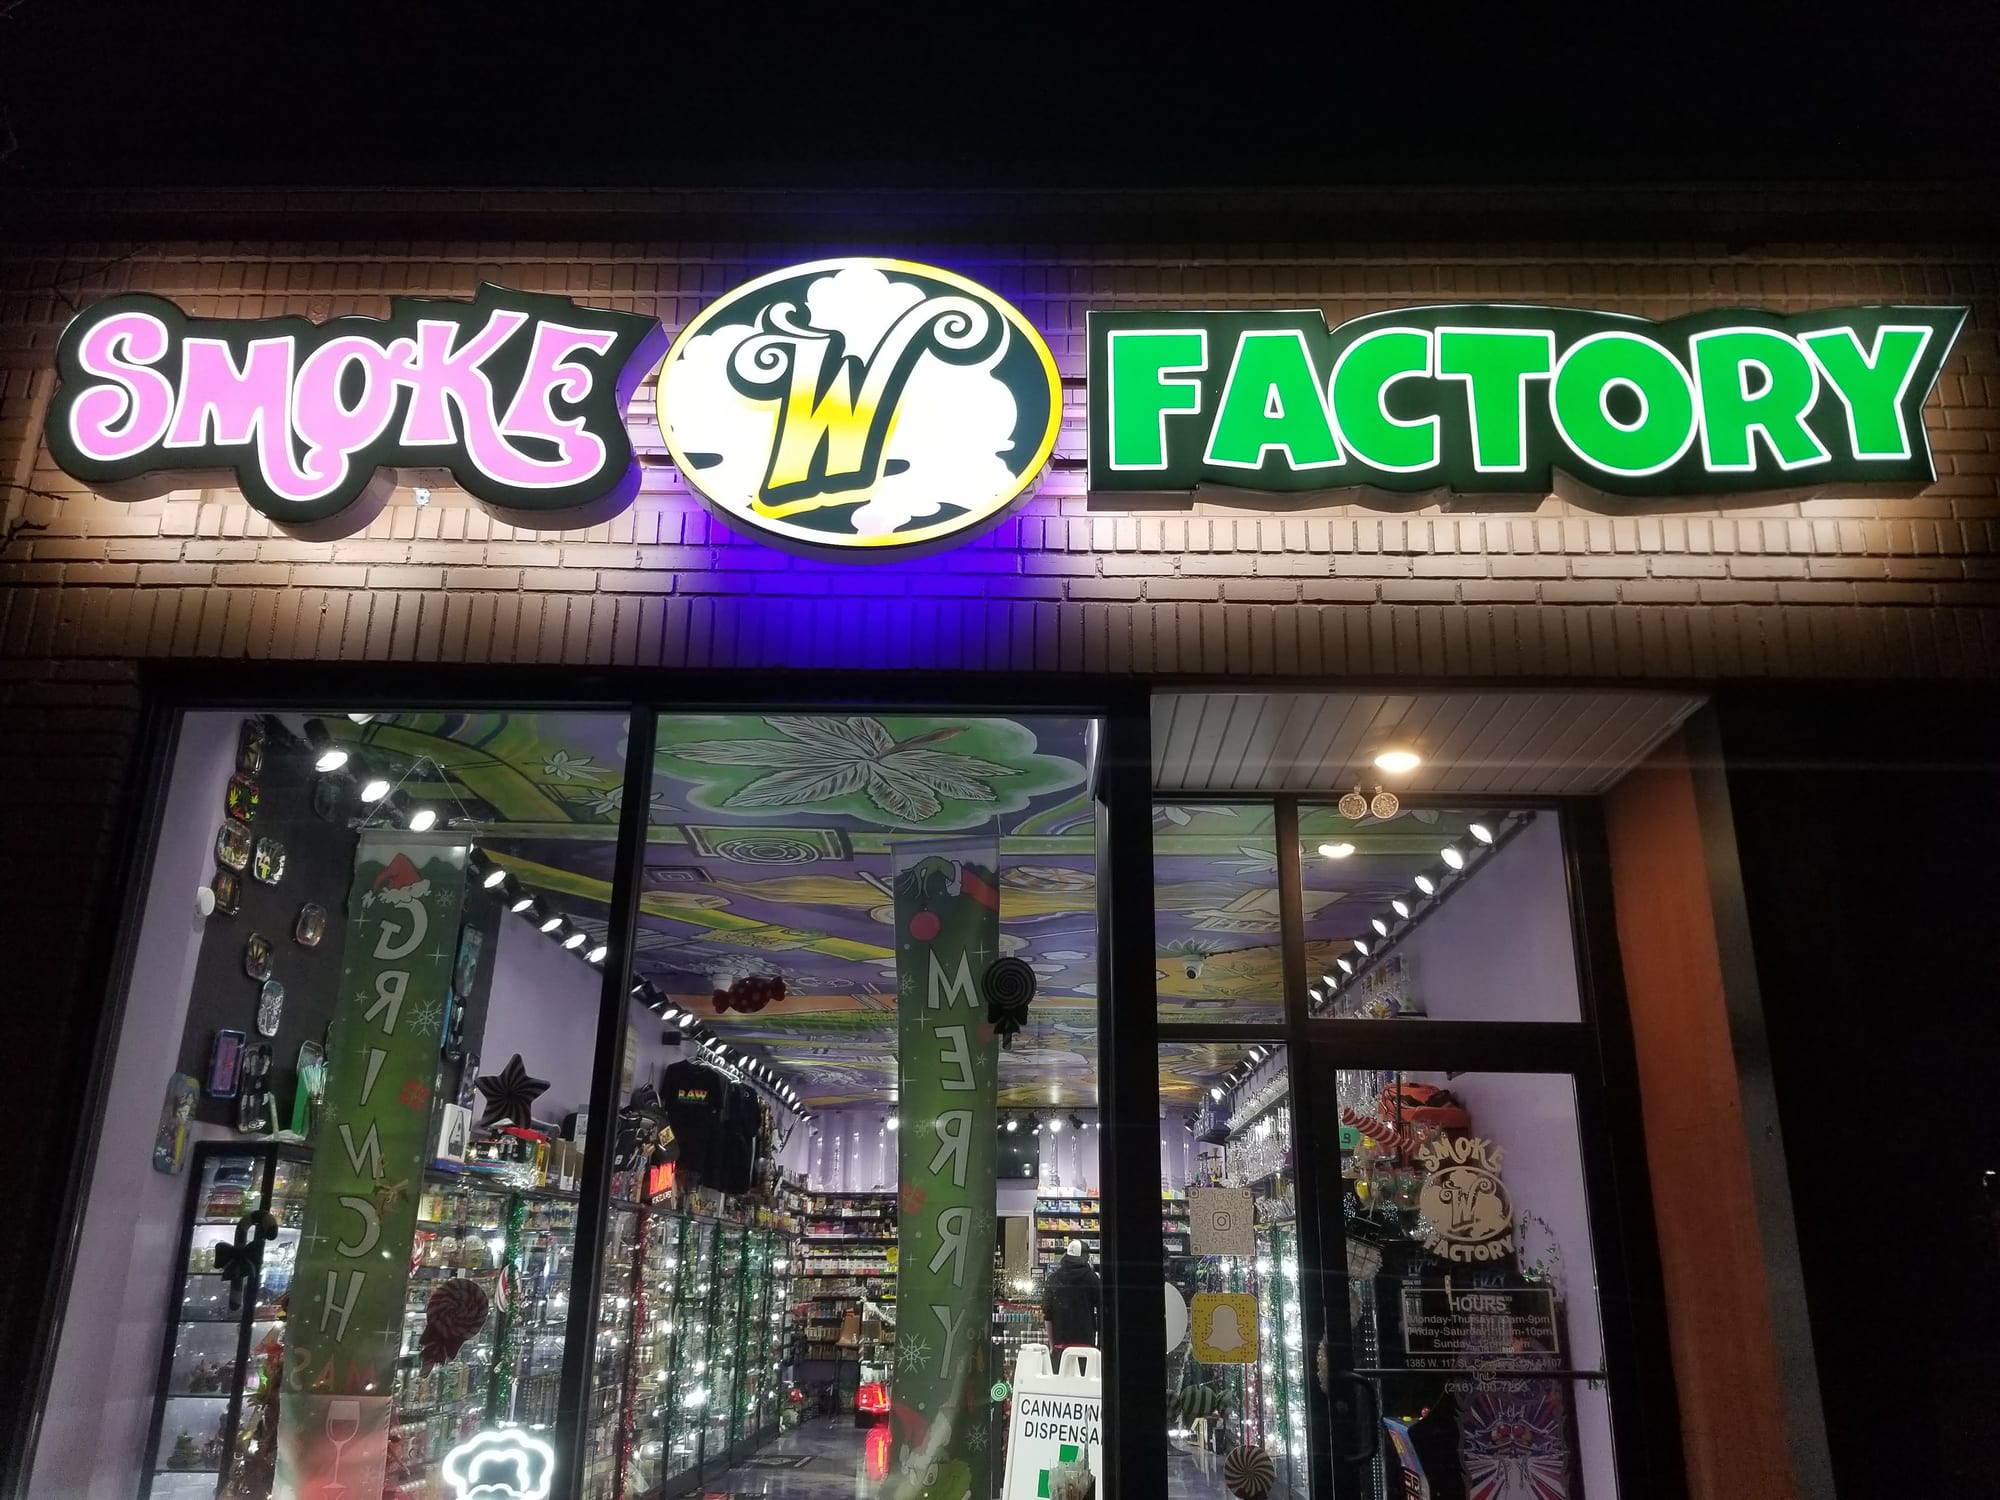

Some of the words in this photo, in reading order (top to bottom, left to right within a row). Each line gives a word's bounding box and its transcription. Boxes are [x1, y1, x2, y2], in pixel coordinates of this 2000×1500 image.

[68, 308, 618, 502] SMOKE
[733, 295, 992, 494] W
[1107, 325, 1933, 477] FACTORY
[678, 1089, 709, 1101] RAW
[1419, 1136, 1505, 1172] SMOKE
[1423, 1235, 1515, 1263] FACTORY
[1449, 1296, 1507, 1312] HOURS
[1405, 1358, 1426, 1368] 1385
[1020, 1399, 1102, 1422] CANNABIN
[1024, 1421, 1102, 1446] DISPENSA
